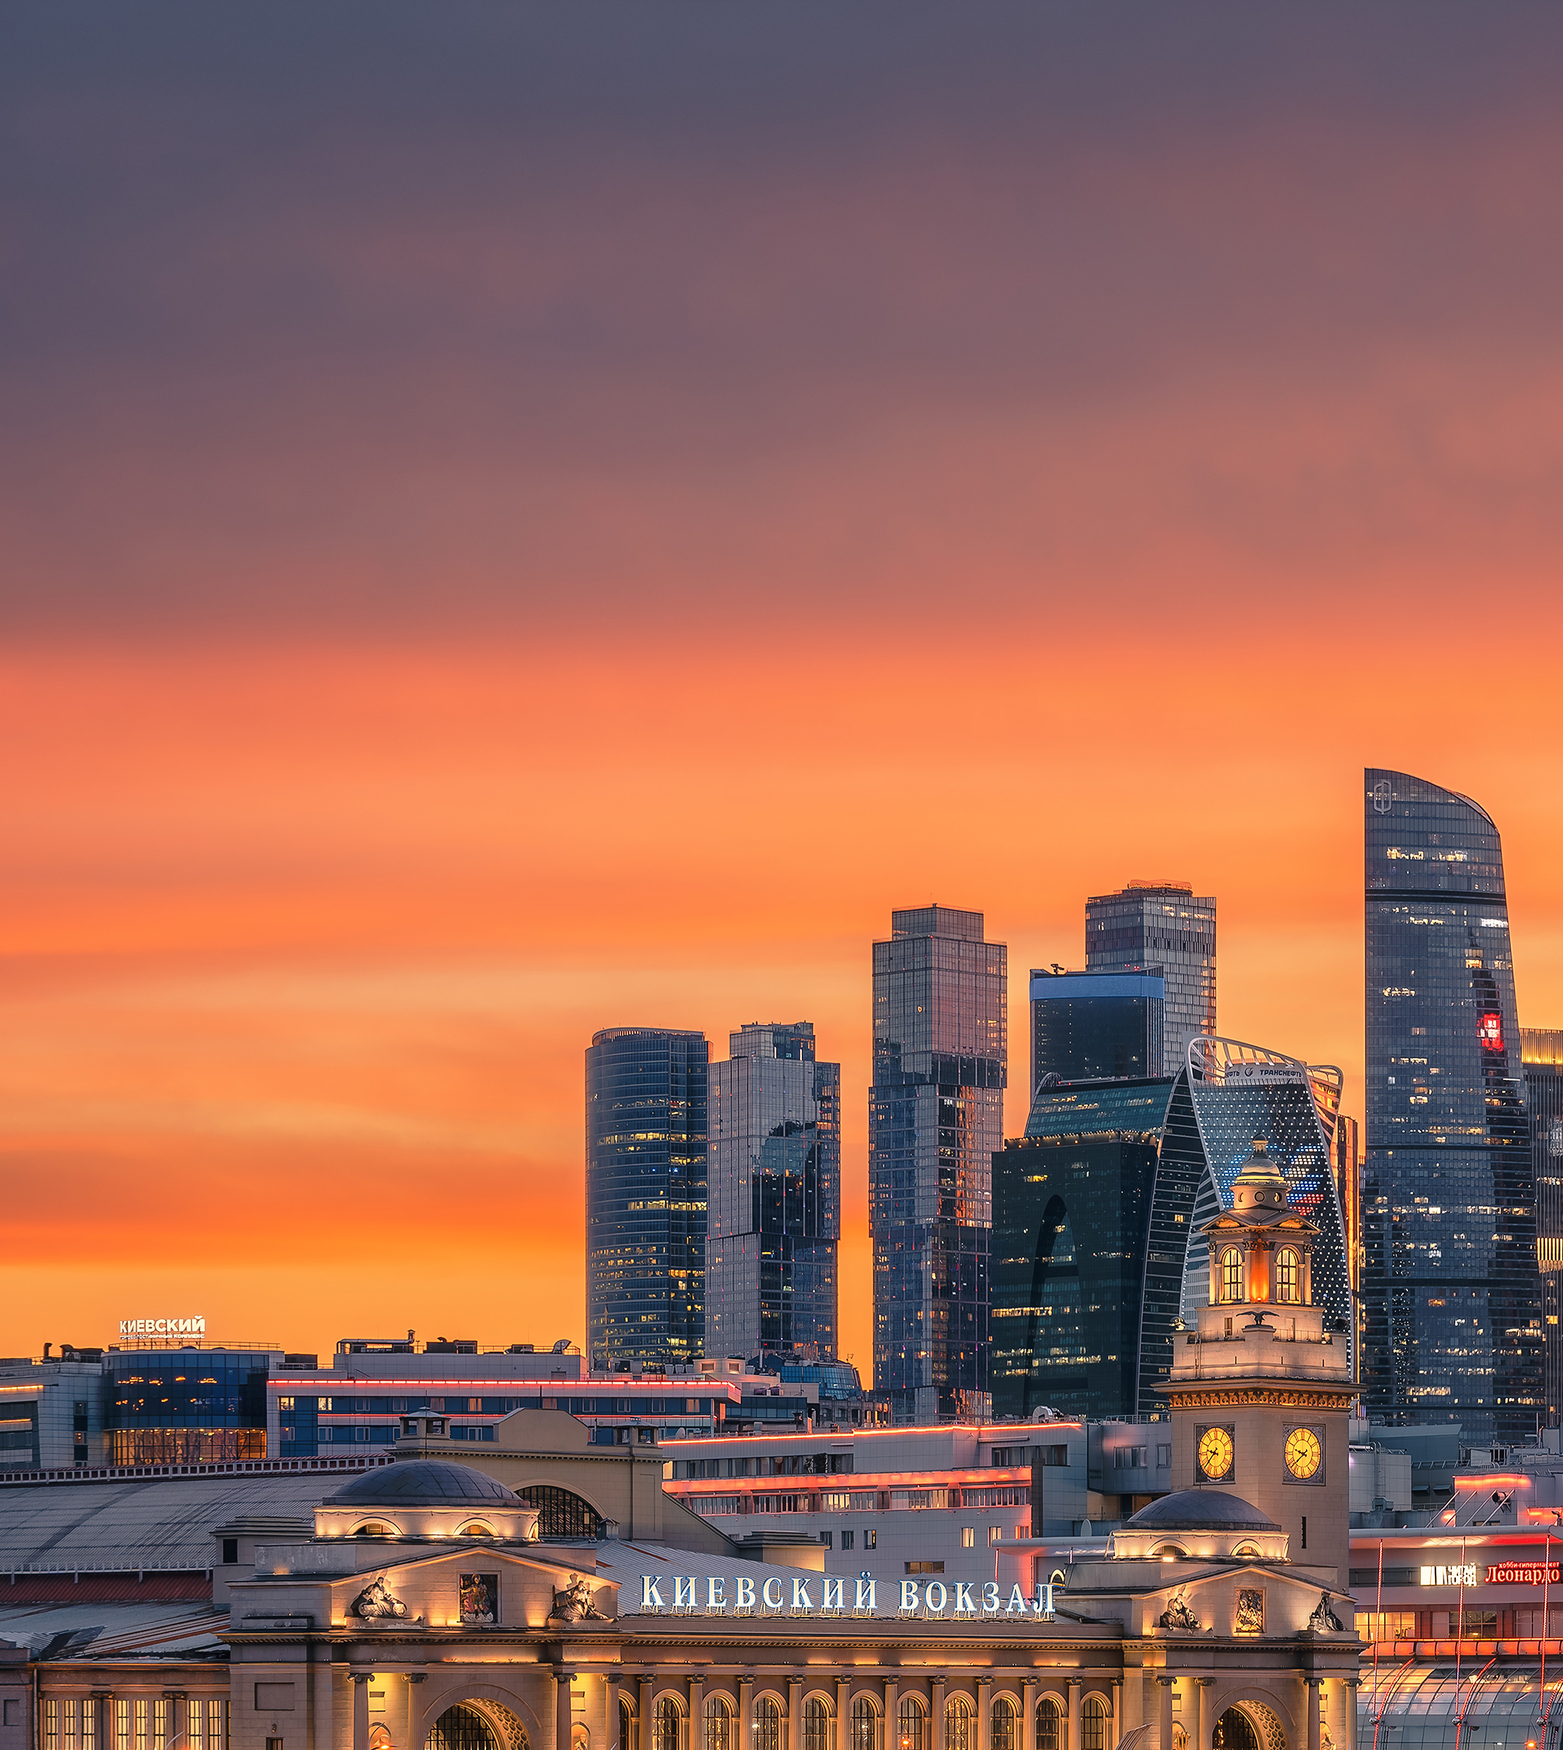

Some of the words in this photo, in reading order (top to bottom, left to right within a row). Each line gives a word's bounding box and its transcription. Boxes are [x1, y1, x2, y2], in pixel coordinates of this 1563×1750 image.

[120, 1315, 205, 1333] КИЕВСКИЙ
[1499, 1561, 1559, 1569] хобби-гипермакет
[1484, 1566, 1560, 1586] Леонардо
[640, 1571, 878, 1609] КИЕВСКИЙ
[899, 1580, 1055, 1614] ВОКЗАЛ
